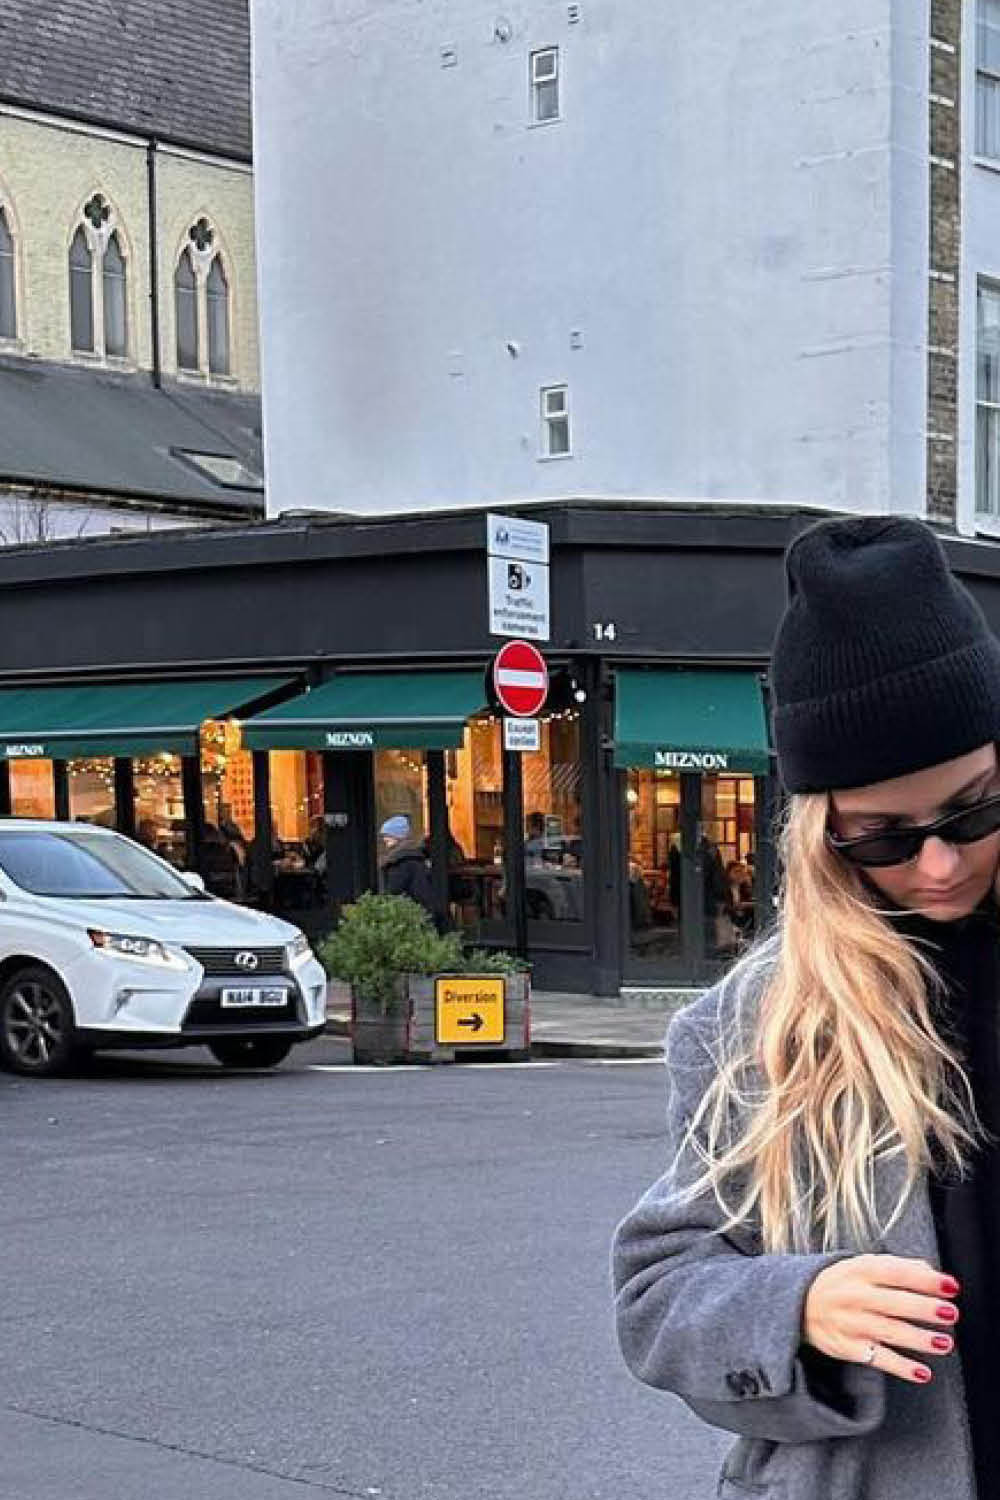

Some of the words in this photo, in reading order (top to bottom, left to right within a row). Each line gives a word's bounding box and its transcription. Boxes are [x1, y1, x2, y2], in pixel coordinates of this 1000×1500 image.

[592, 622, 617, 641] 14
[325, 731, 374, 747] MIZNON
[5, 743, 45, 756] MIZNON
[653, 750, 728, 769] MIZNON
[443, 988, 498, 1005] Diversion
